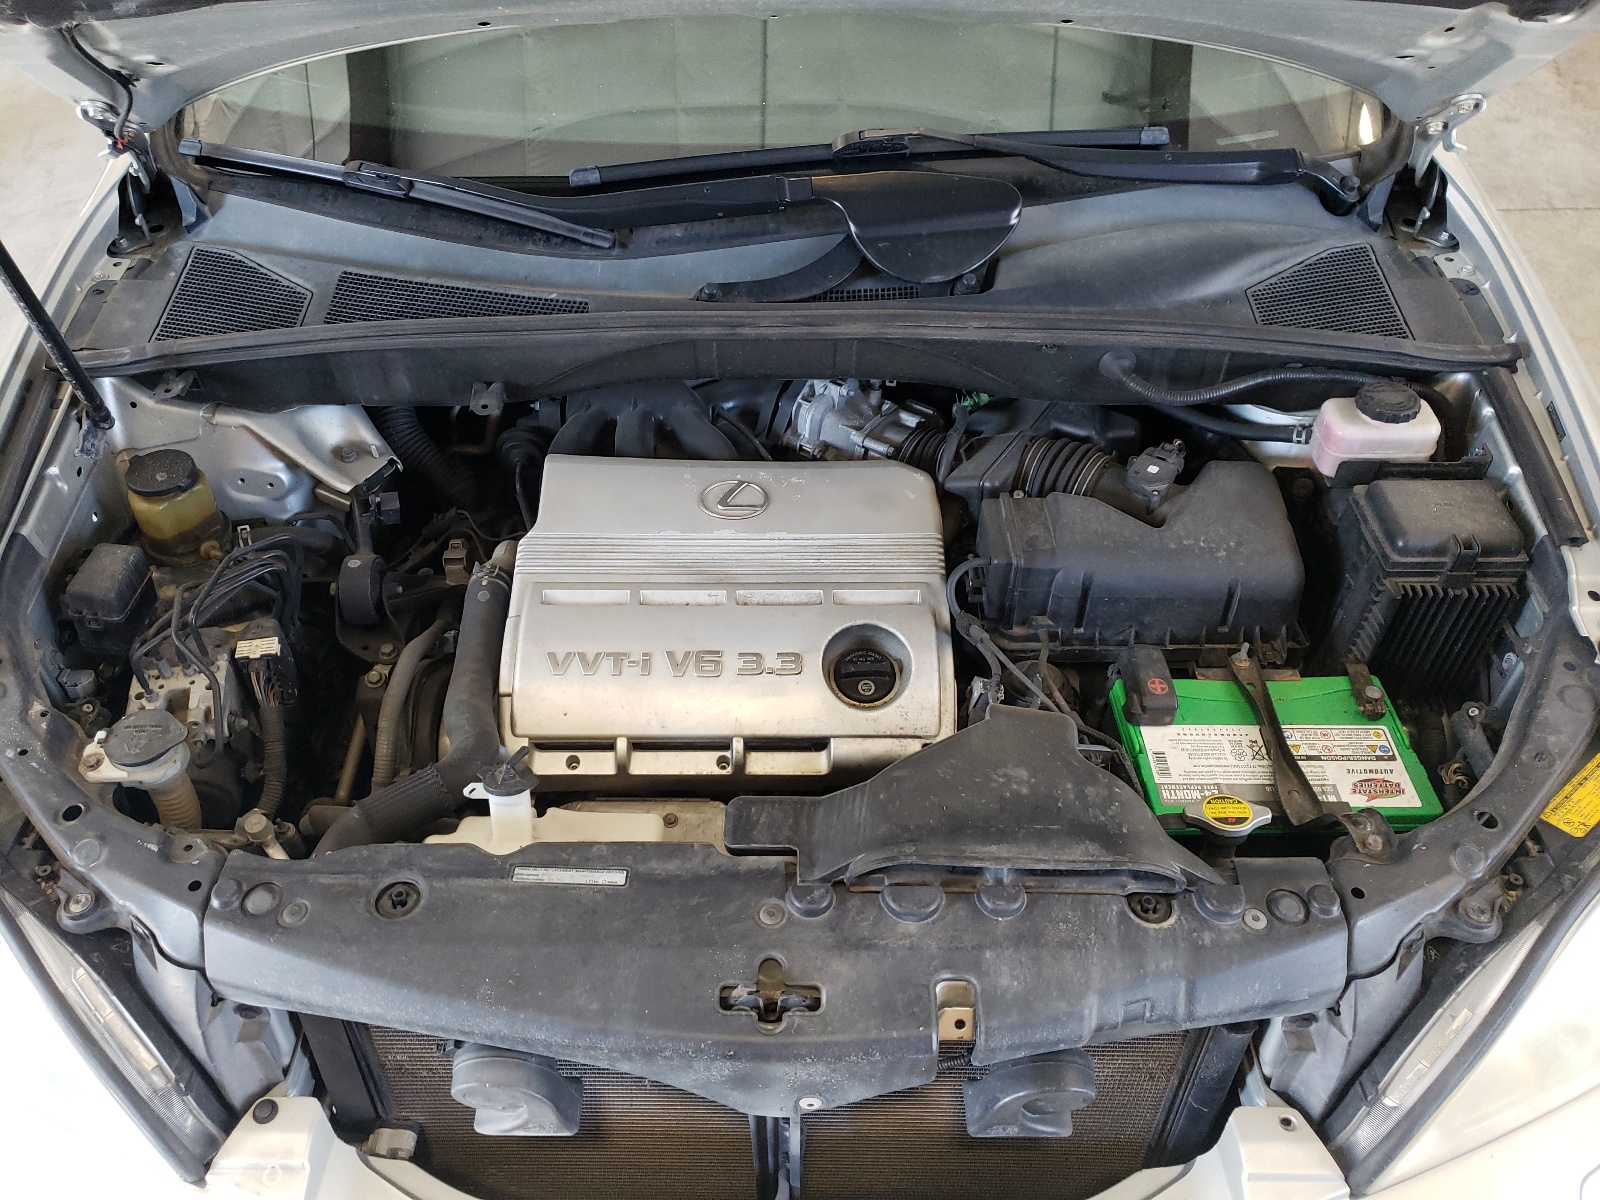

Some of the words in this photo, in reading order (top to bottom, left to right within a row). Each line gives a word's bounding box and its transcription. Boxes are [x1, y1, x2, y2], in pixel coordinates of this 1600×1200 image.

[545, 650, 652, 677] VVT-i
[664, 649, 724, 678] V6
[735, 651, 804, 677] 3.3
[1350, 787, 1405, 796] INTERSTATE
